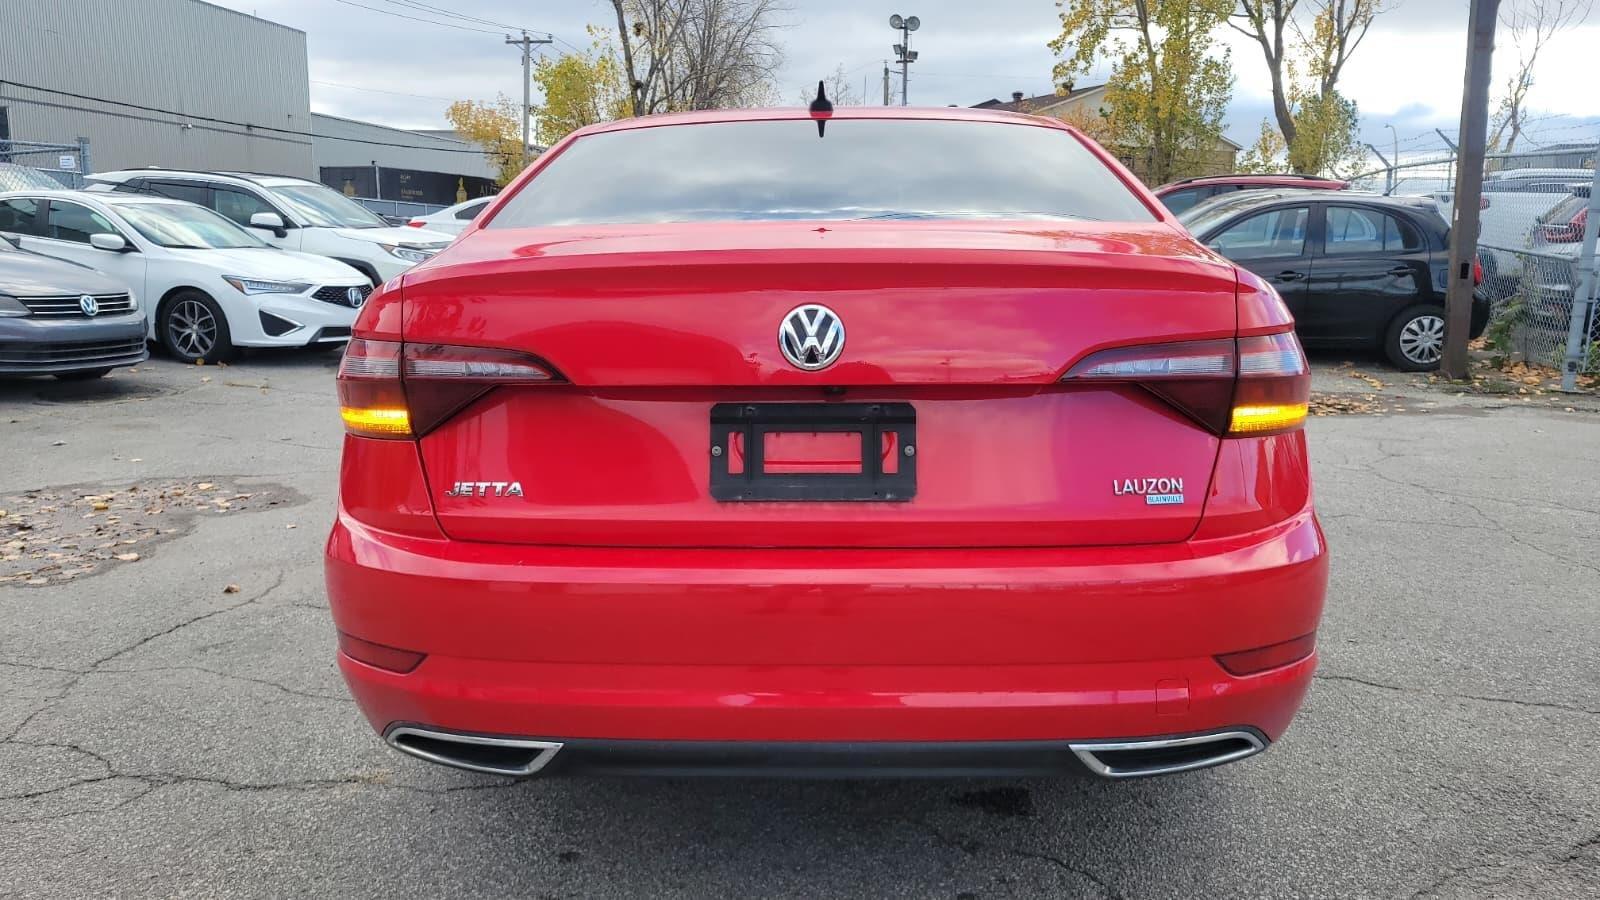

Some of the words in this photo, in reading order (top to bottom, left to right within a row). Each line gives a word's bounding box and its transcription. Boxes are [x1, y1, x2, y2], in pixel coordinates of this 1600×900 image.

[778, 303, 845, 370] VW
[444, 481, 524, 497] JETTA
[1113, 478, 1183, 495] LAUZON
